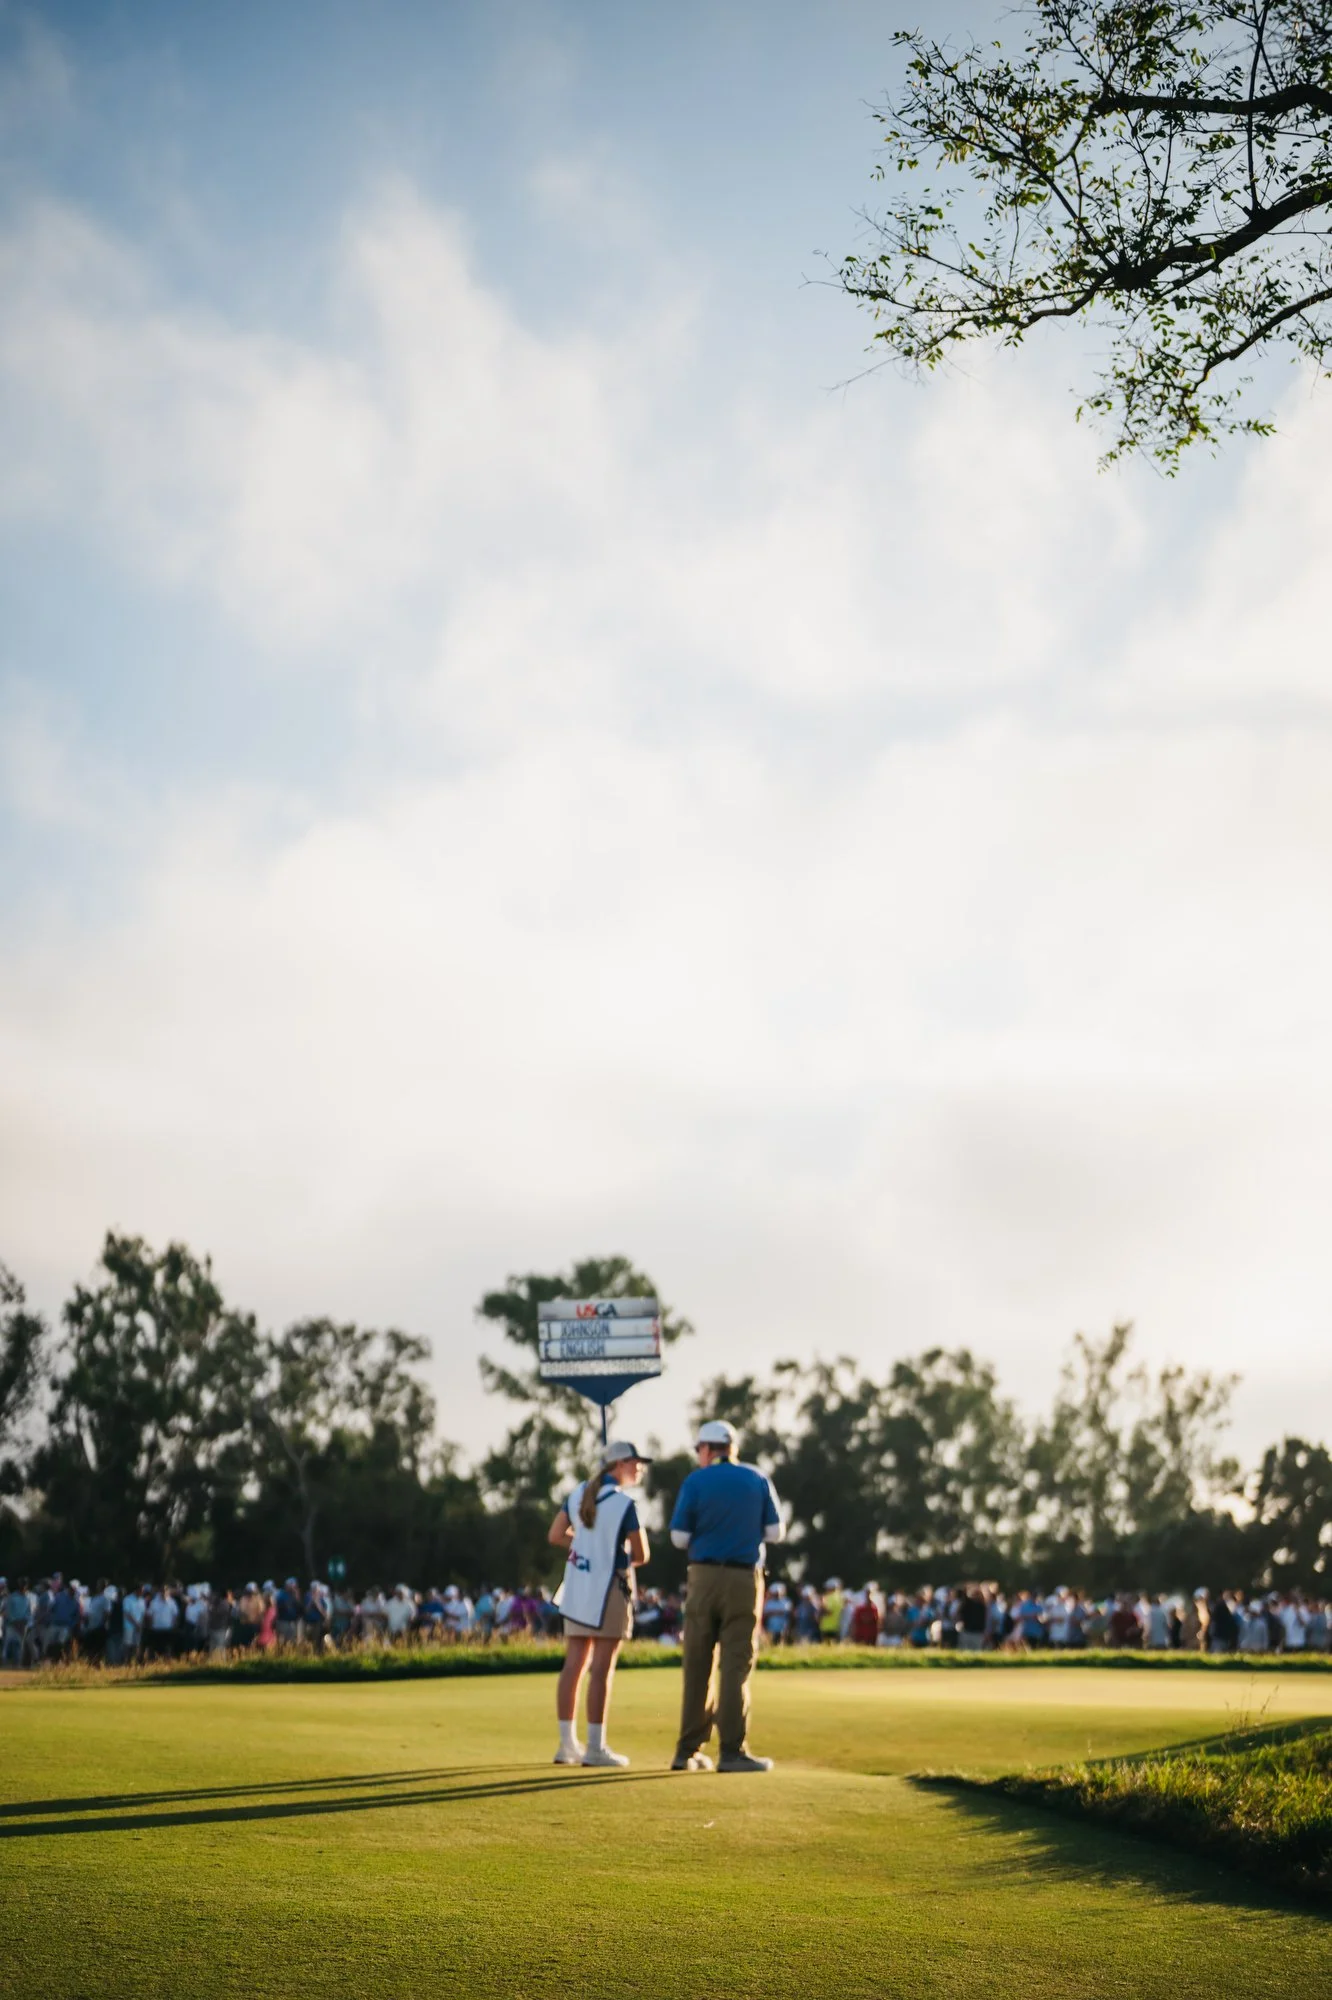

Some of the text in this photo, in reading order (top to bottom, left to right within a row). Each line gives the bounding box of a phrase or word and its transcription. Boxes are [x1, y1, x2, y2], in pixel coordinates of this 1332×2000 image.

[576, 1303, 617, 1318] USGA
[561, 1320, 611, 1337] JOHNSON
[559, 1338, 606, 1358] ENGLISH
